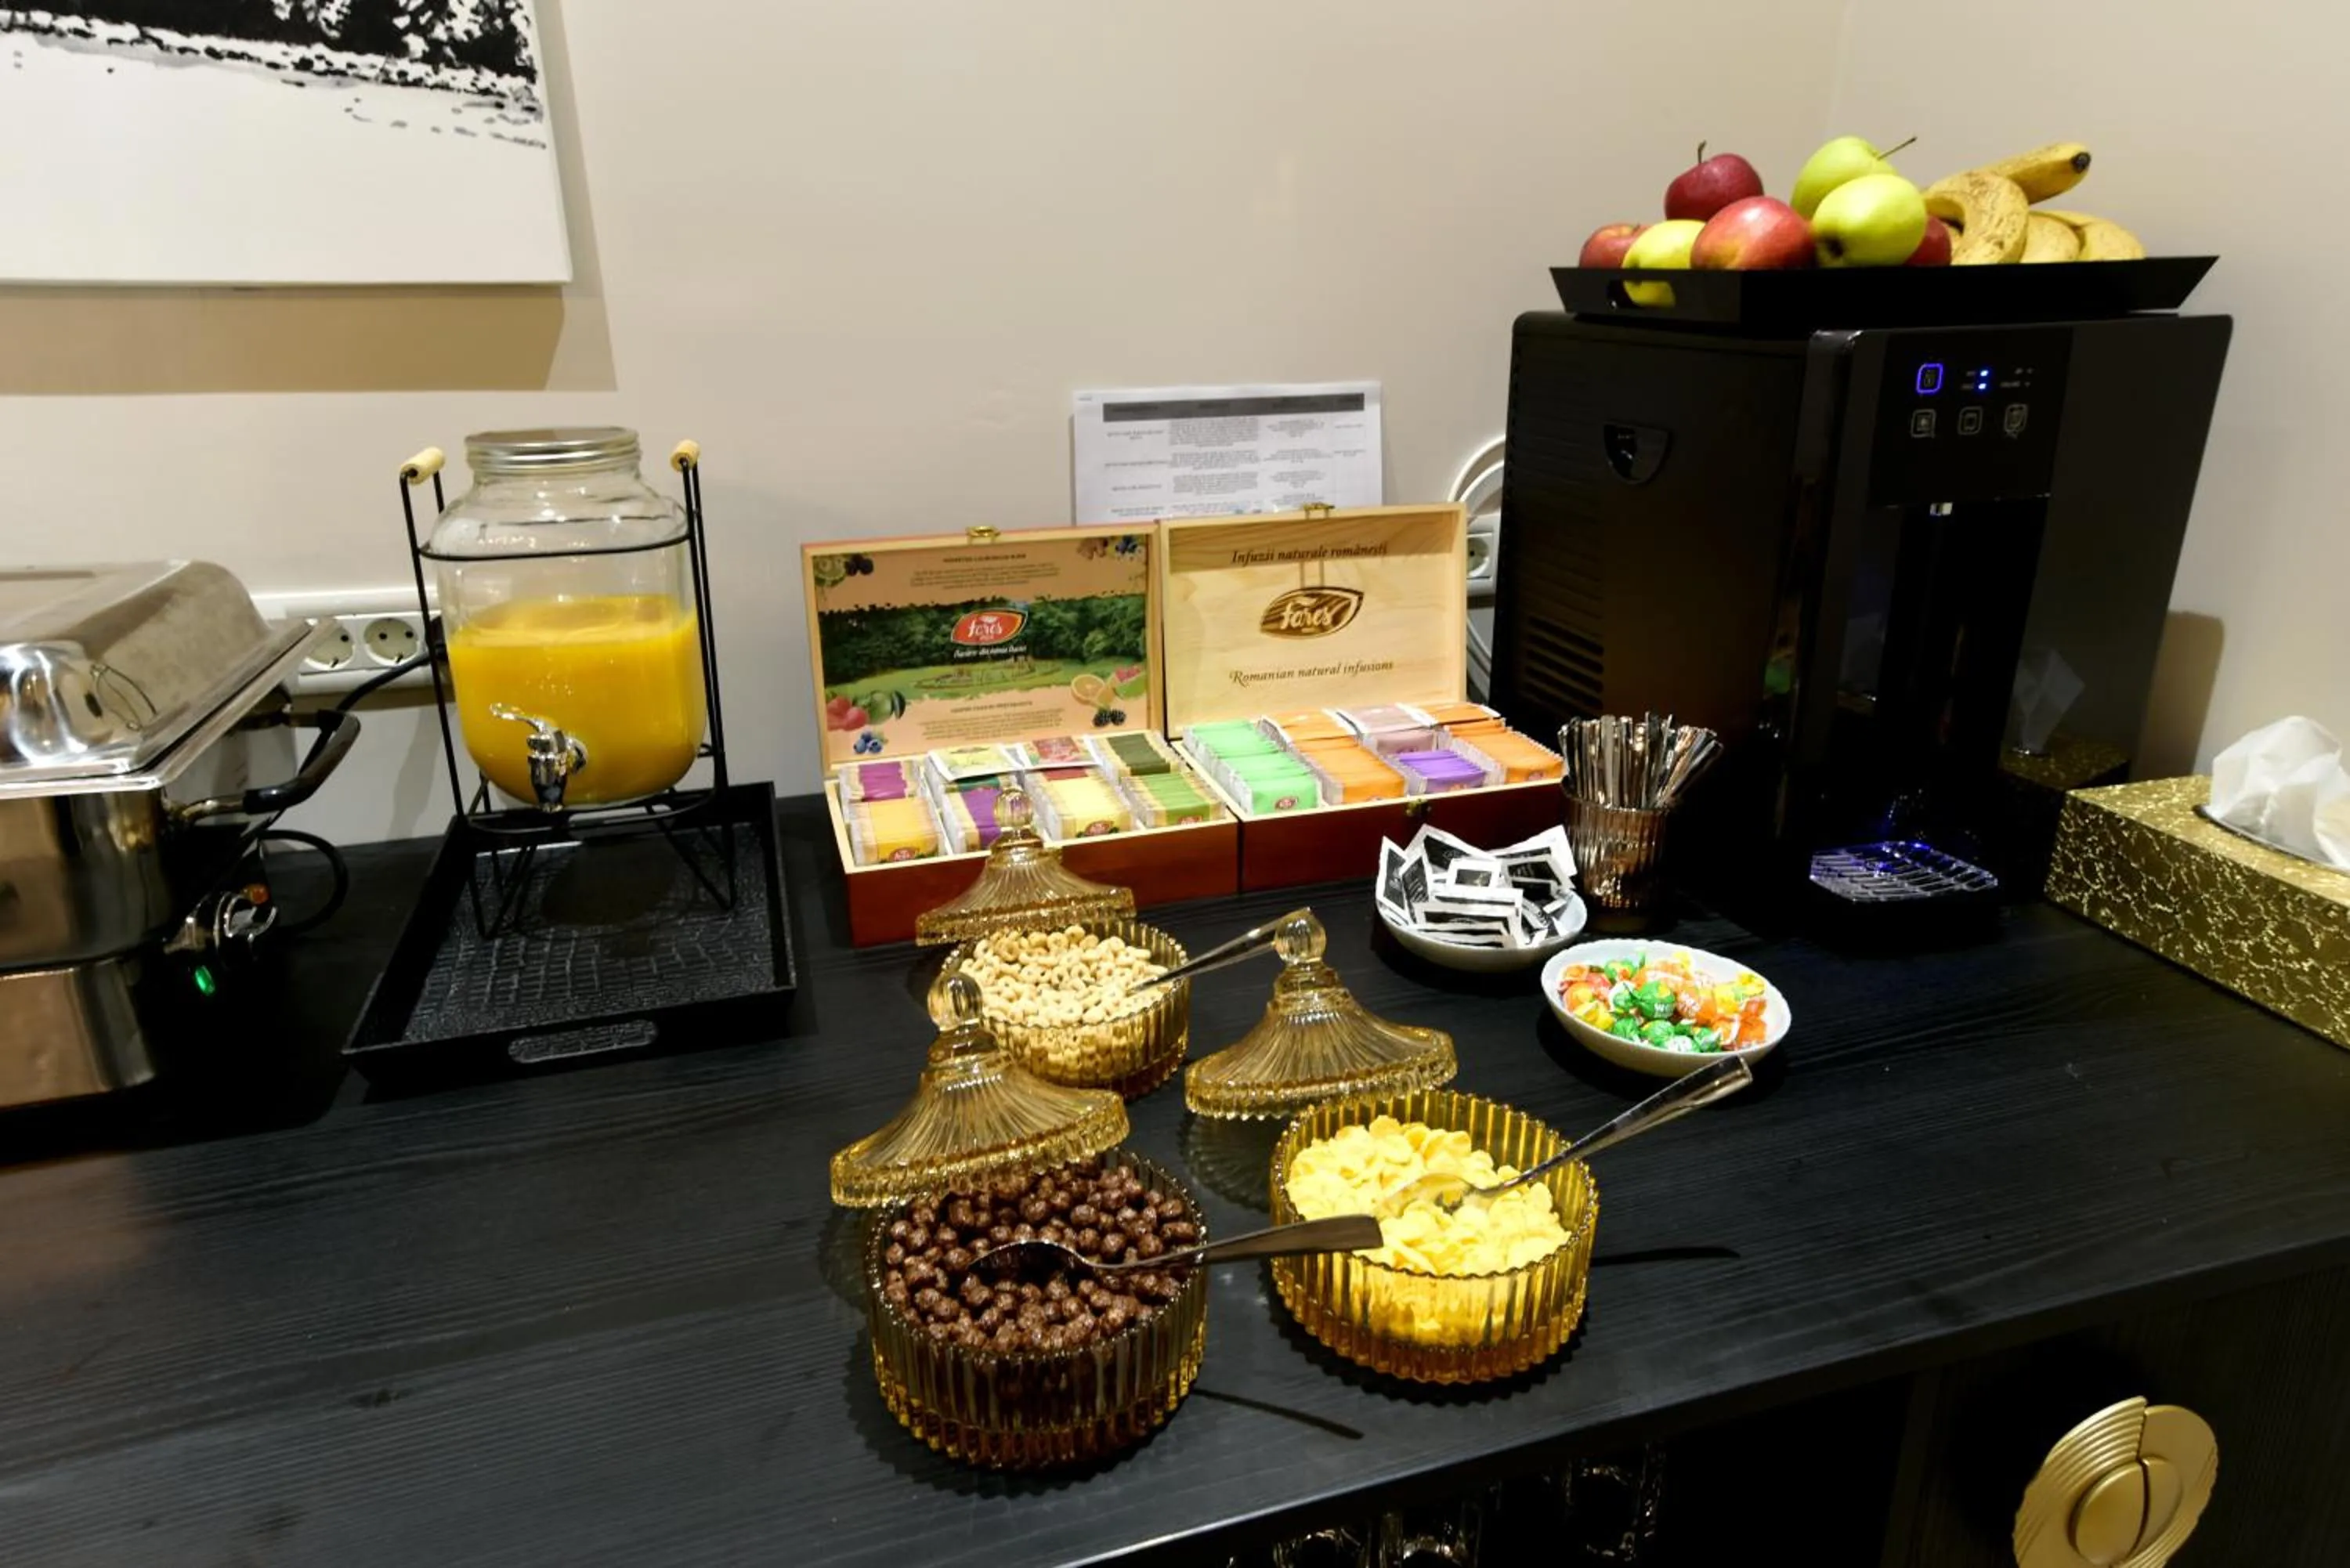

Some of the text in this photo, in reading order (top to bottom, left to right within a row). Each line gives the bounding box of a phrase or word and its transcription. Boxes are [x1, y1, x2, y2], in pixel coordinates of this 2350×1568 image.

[1231, 547, 1274, 567] Infuzii
[1278, 544, 1329, 562] naturale
[1229, 659, 1394, 688] Romanian natural infusions
